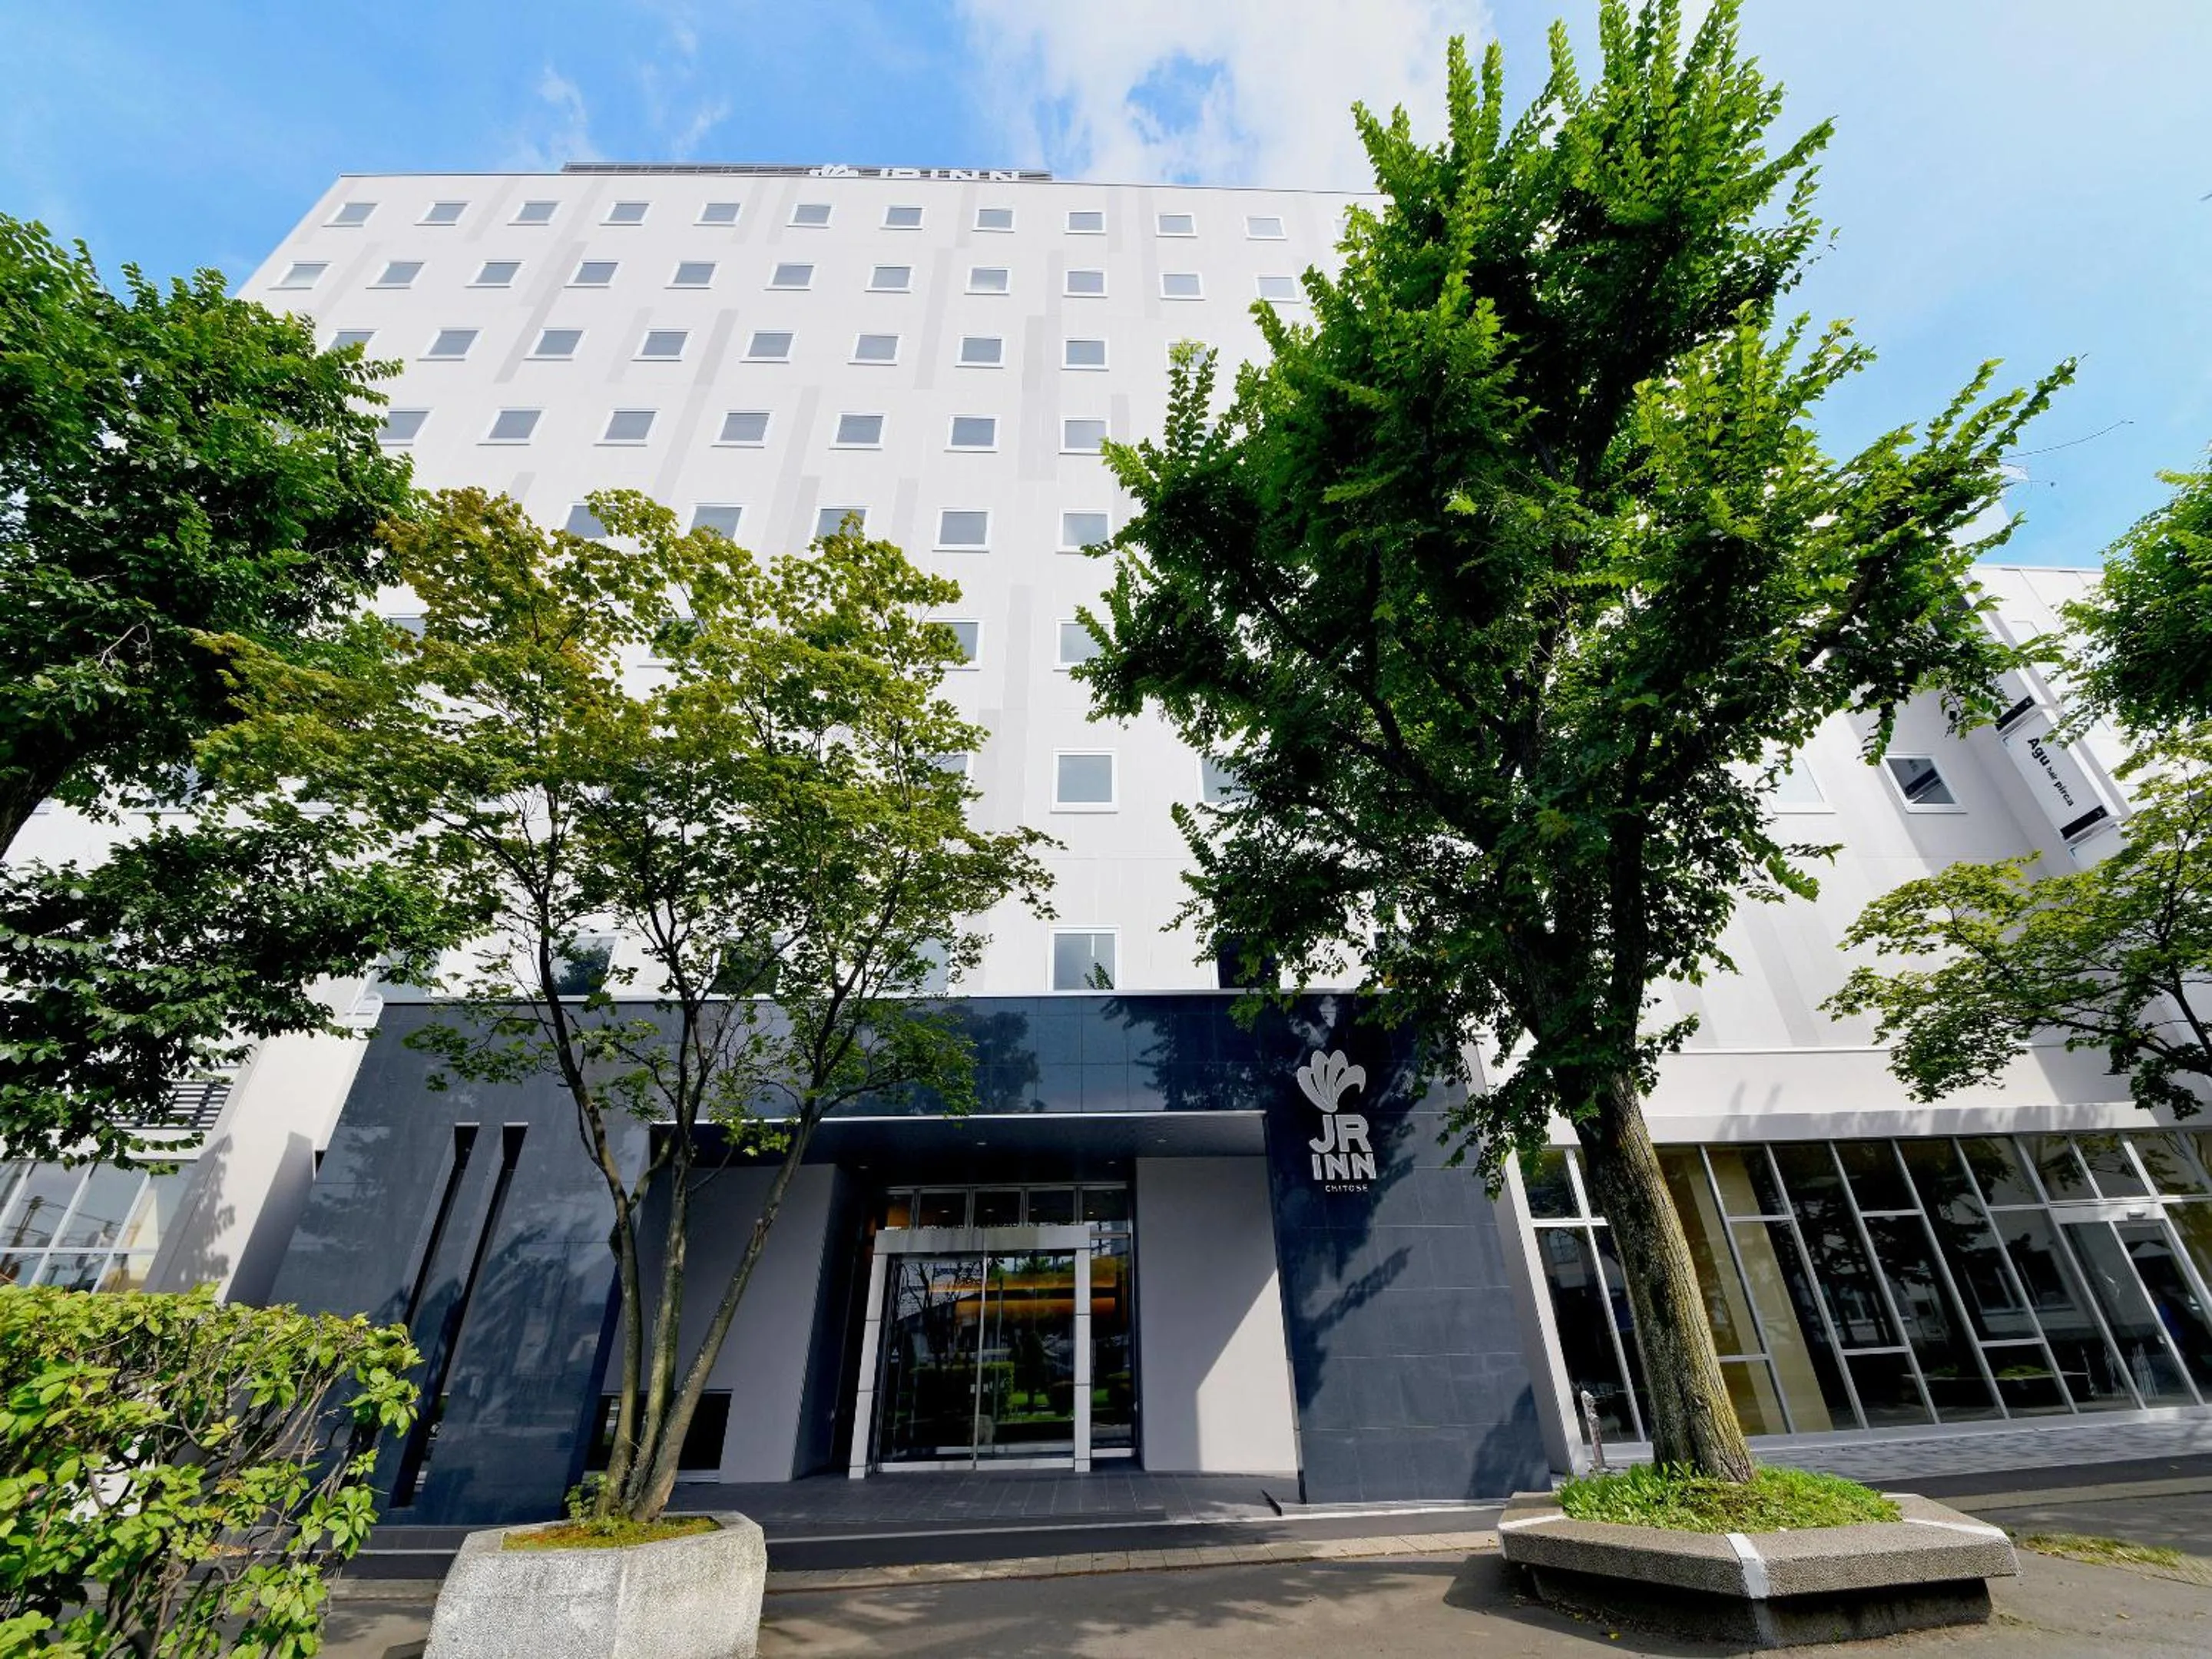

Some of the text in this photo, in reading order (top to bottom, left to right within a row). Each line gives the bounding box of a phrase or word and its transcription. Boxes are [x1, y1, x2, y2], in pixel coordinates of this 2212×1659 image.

[2027, 737, 2051, 767] Agu
[2053, 781, 2074, 806] pirca
[1309, 1114, 1373, 1153] JR
[1312, 1153, 1376, 1180] INN
